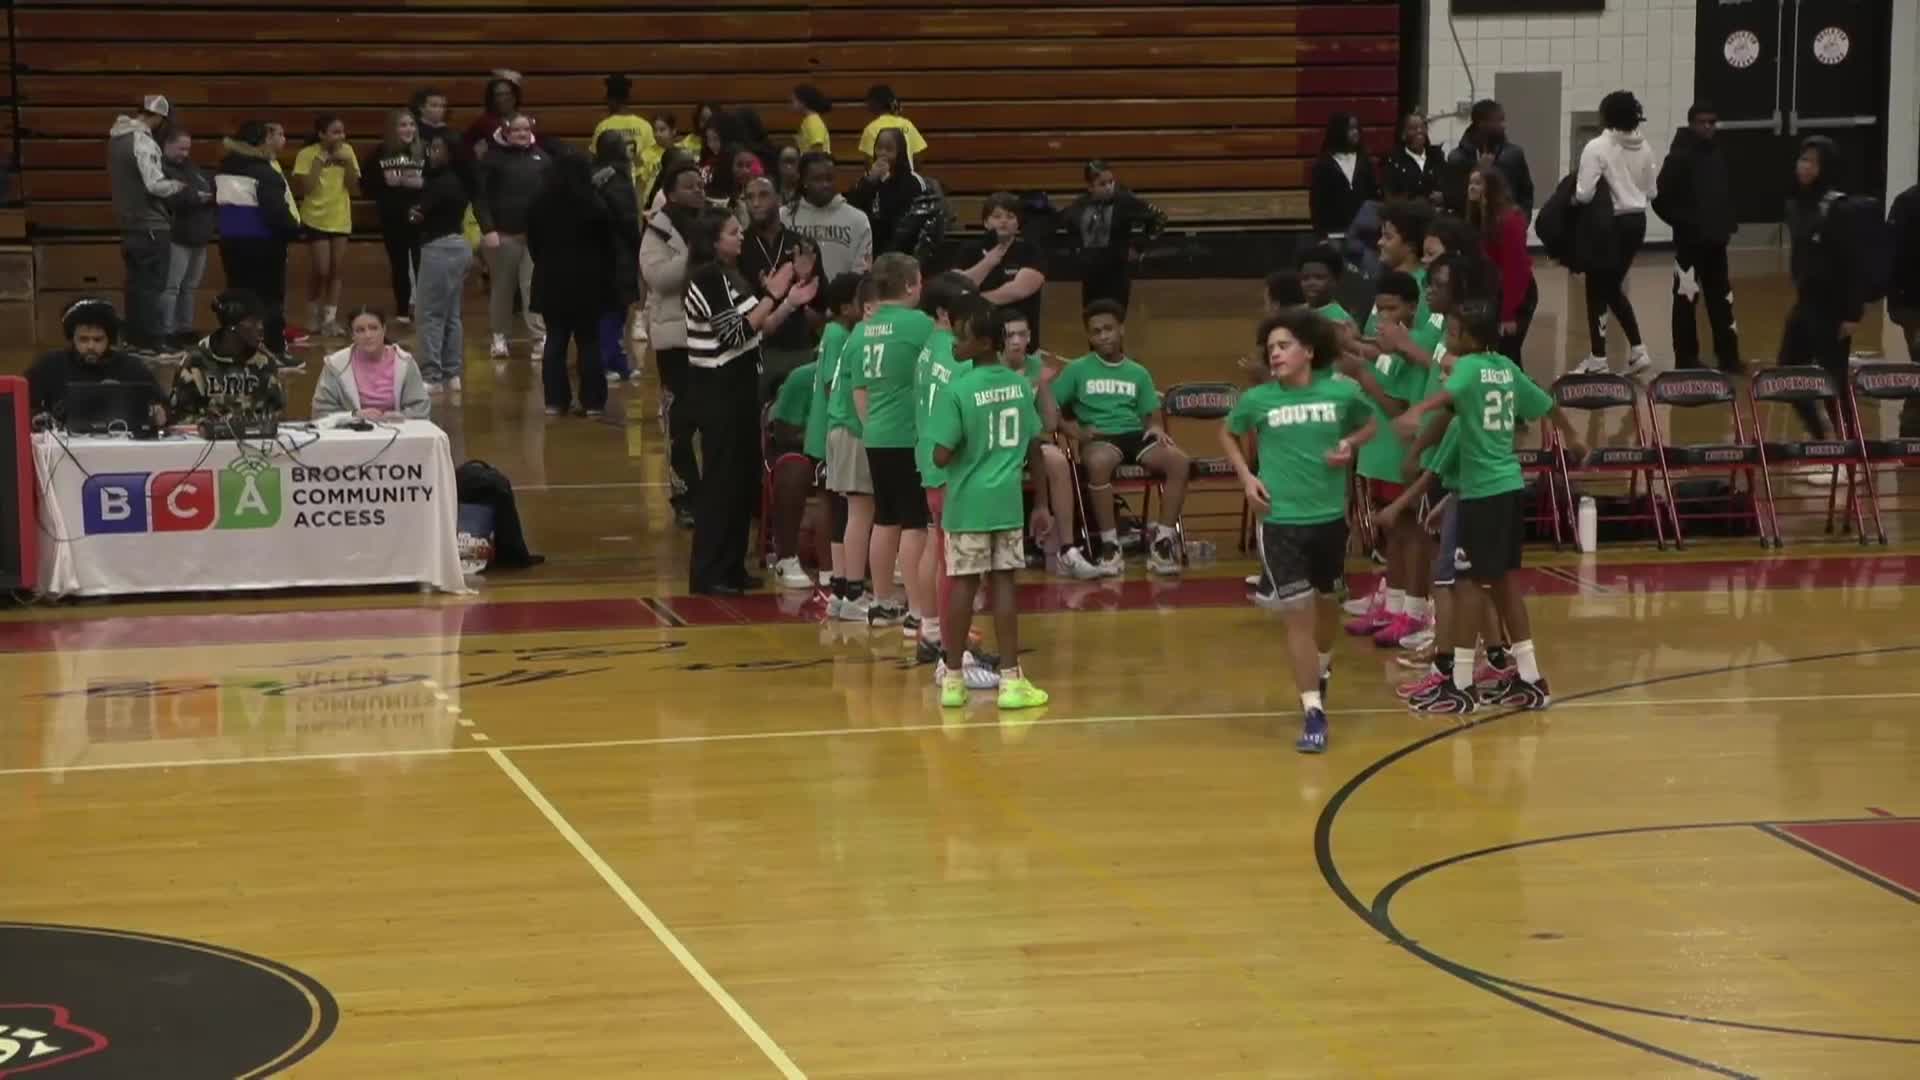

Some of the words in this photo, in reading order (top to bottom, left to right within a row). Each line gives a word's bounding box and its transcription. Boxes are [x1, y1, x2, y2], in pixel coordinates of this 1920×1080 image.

[863, 343, 885, 379] 27
[1086, 379, 1137, 397] SOUTH
[1268, 402, 1337, 427] SOUTH
[1483, 390, 1514, 431] 23
[988, 407, 1020, 450] 10
[291, 464, 423, 483] BROCKTON
[292, 486, 434, 505] COMMUNITY
[294, 509, 386, 528] ACCESS
